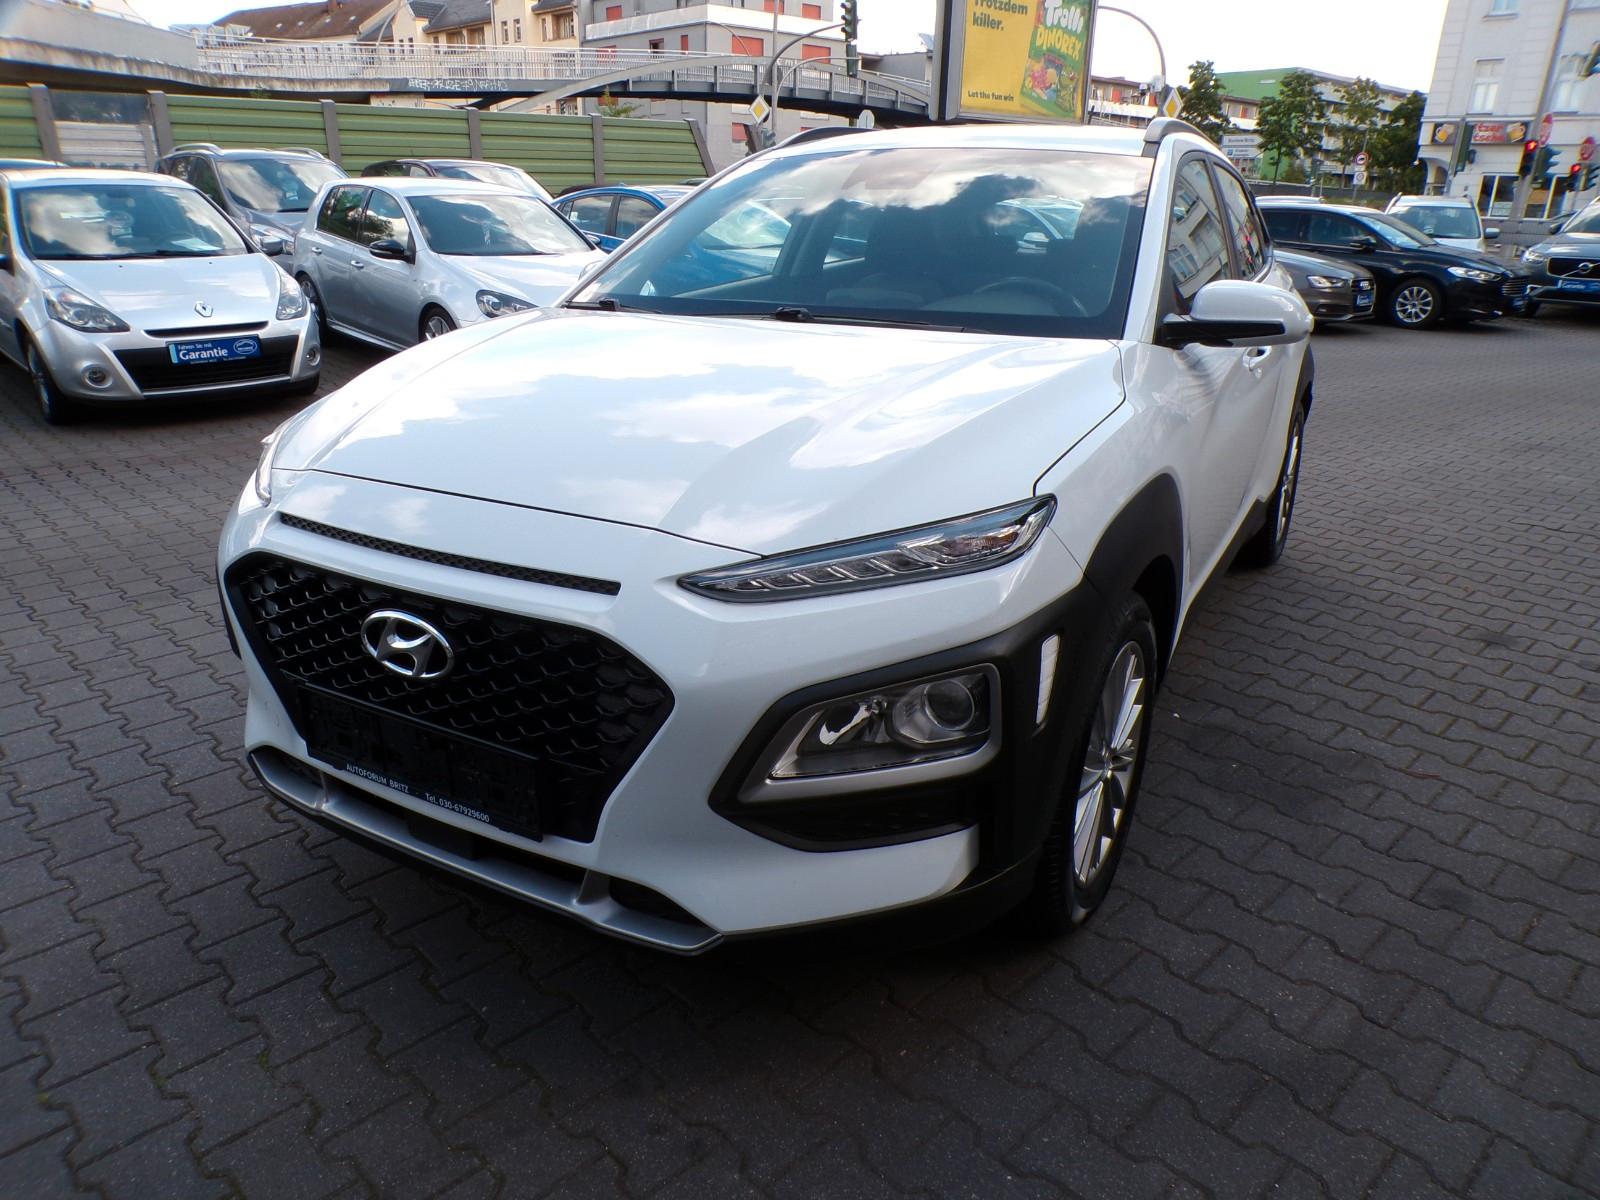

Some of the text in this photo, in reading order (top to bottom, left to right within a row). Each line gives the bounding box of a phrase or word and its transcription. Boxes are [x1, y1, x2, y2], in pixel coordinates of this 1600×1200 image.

[974, 0, 1028, 16] Trotzdem
[1045, 0, 1083, 33] Trolli
[973, 12, 1004, 31] killer.
[1036, 26, 1082, 60] DINOREX
[968, 90, 1014, 102] Let the fun win
[179, 347, 228, 360] Garantie
[346, 763, 387, 784] AUTOFORUM
[389, 779, 409, 793] BRITZ
[425, 793, 438, 804] Tel.
